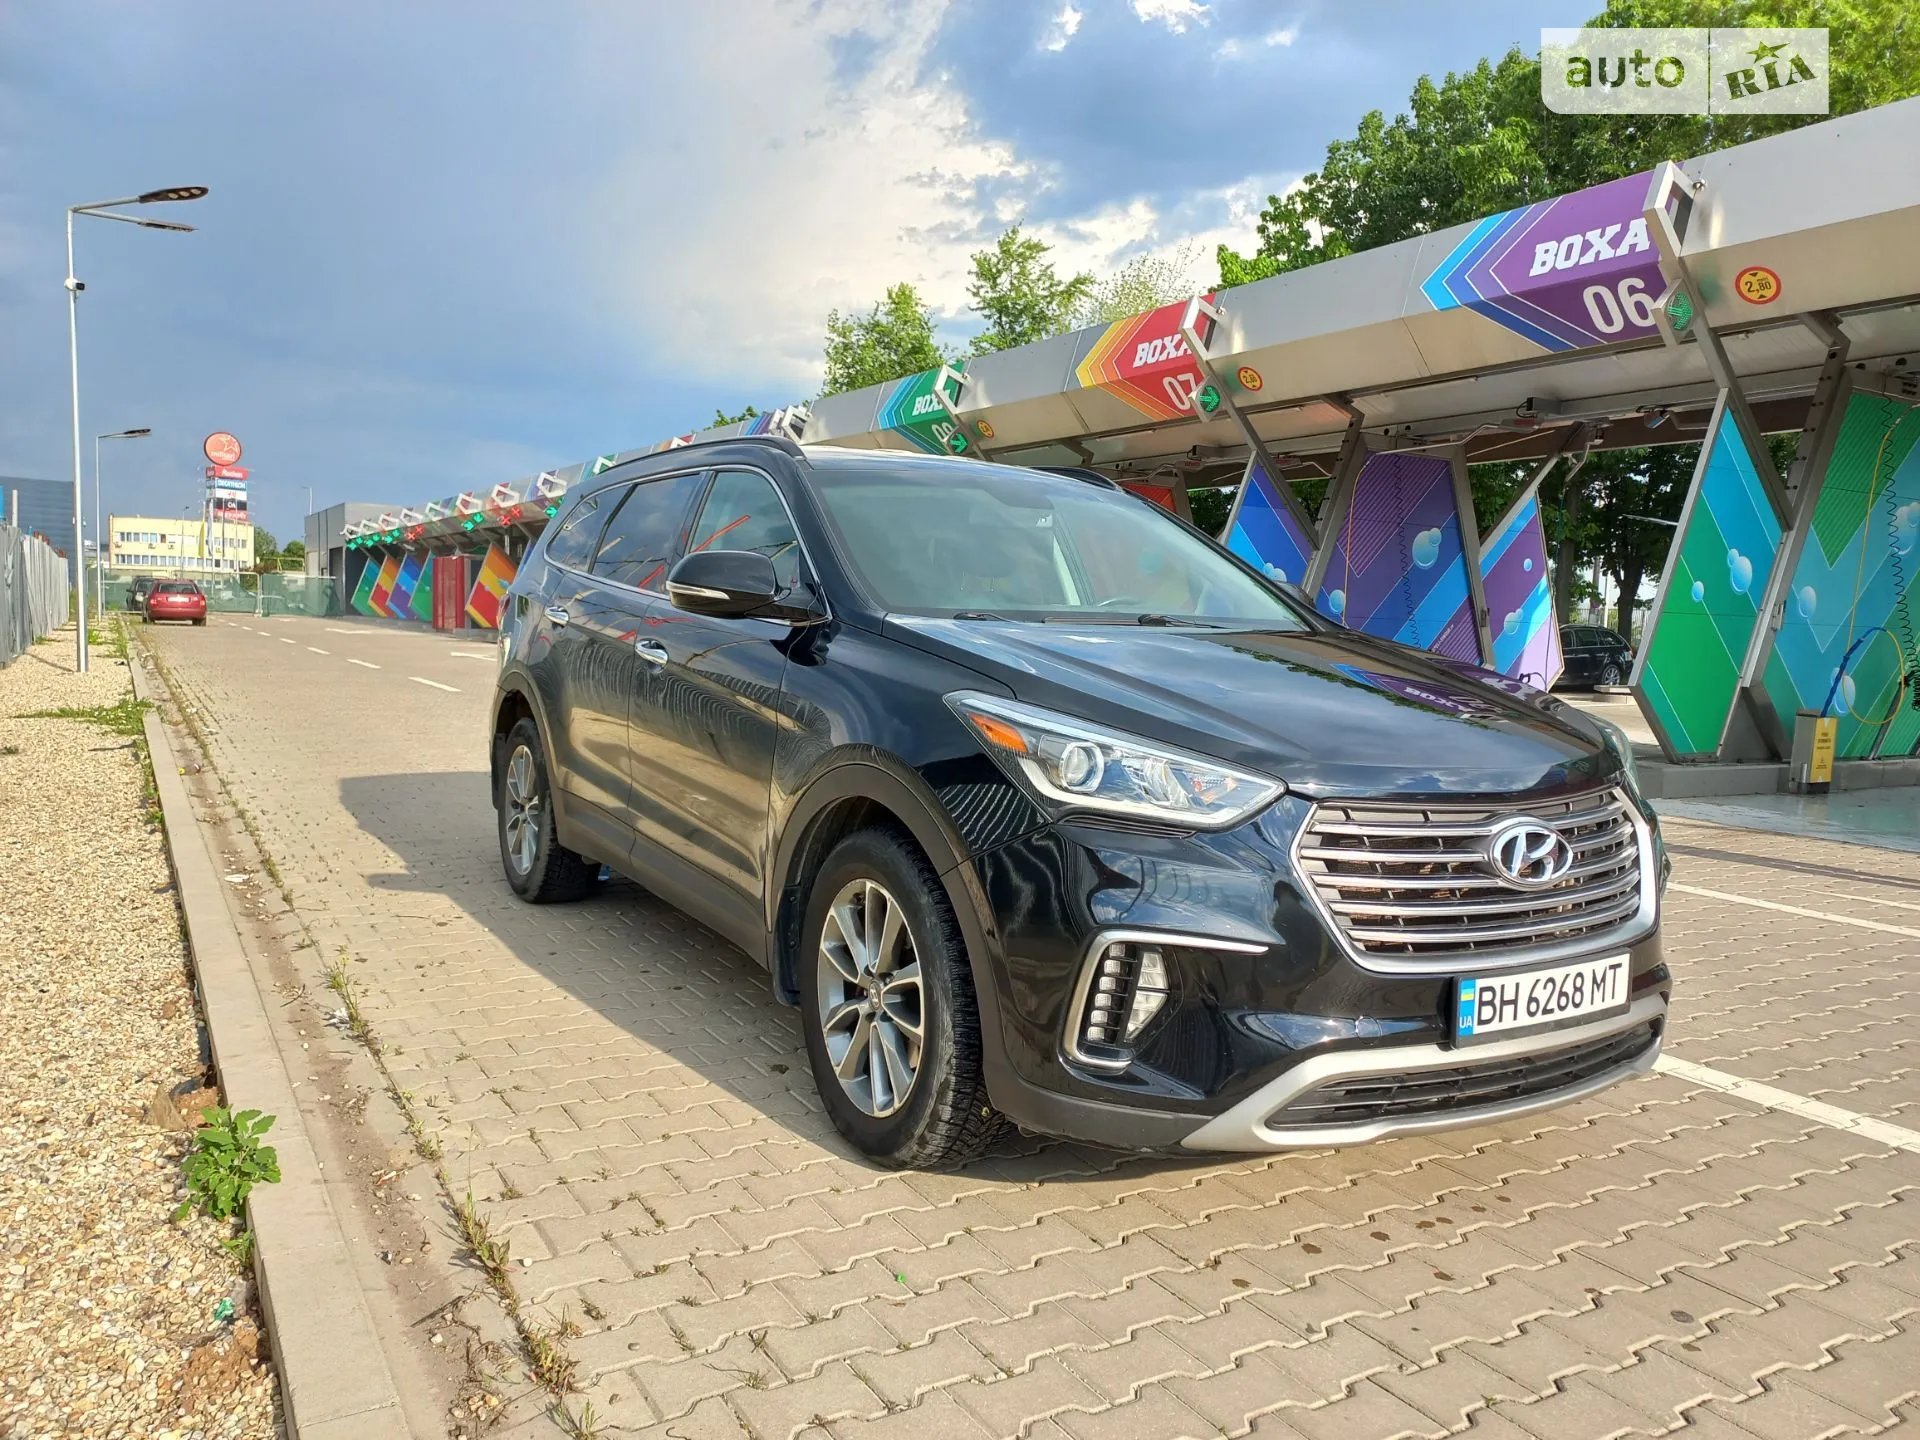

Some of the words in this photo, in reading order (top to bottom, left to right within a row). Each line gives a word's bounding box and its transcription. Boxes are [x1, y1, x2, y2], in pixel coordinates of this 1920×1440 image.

[1529, 217, 1651, 277] BOXA
[1583, 277, 1657, 334] 06
[1745, 280, 1772, 293] 2,80
[1459, 1016, 1473, 1029] UA
[1477, 981, 1521, 1027] BH
[1526, 971, 1585, 1018] 6268
[1590, 962, 1623, 1006] MT
